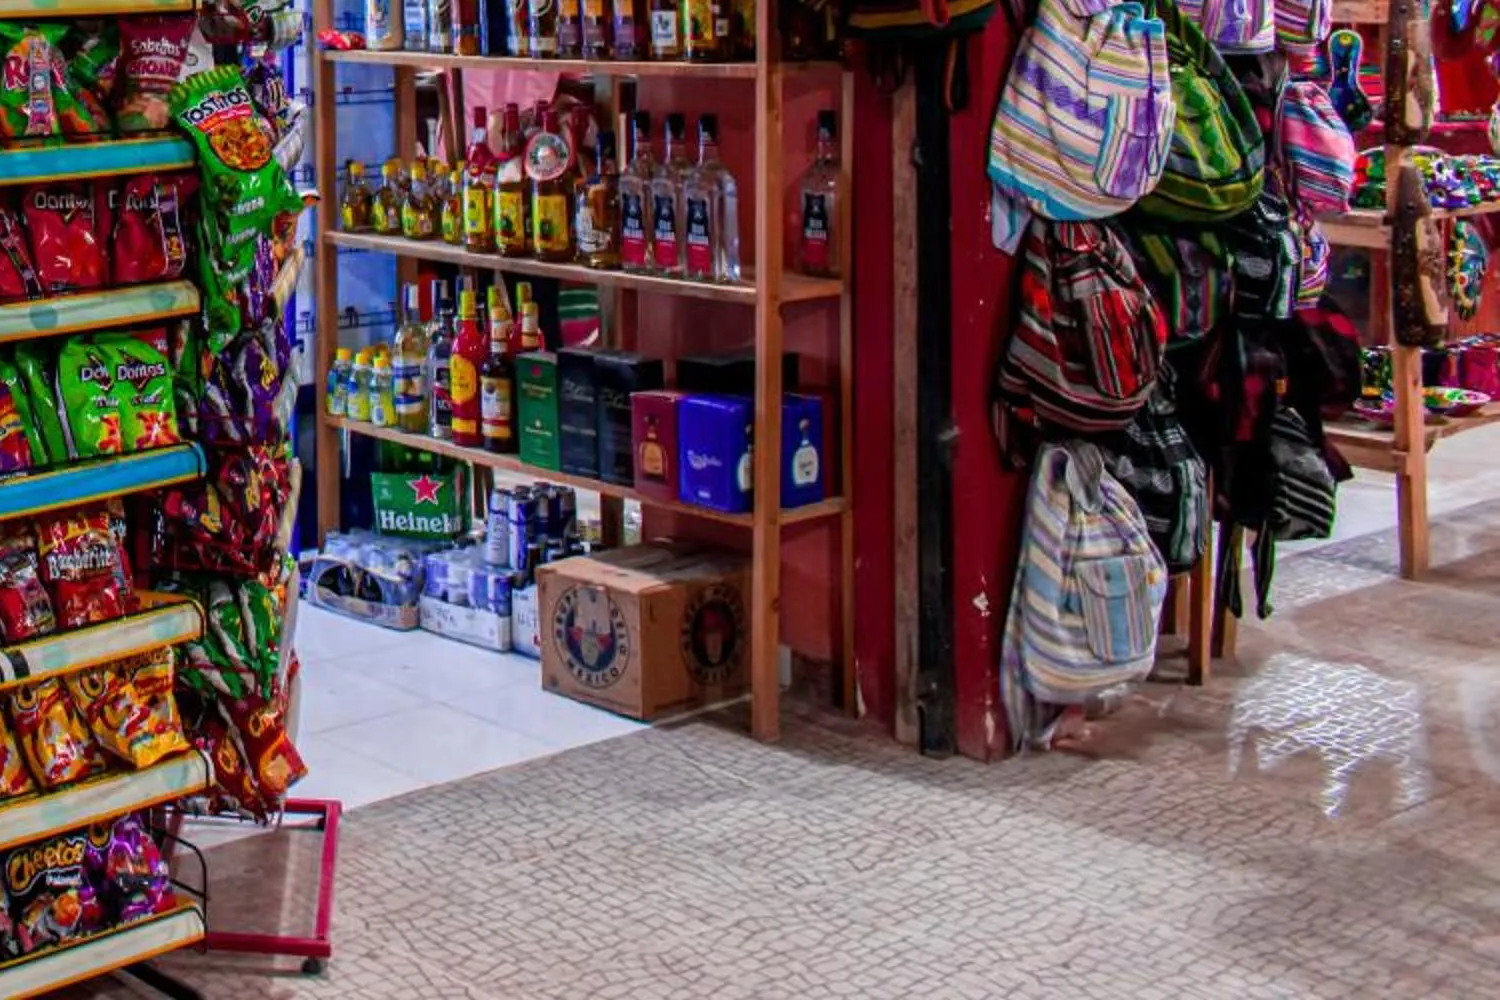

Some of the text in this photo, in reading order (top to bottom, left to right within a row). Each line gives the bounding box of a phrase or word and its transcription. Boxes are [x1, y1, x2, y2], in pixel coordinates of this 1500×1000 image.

[131, 36, 182, 56] Sabritas
[117, 362, 166, 381] Doritos
[8, 840, 85, 892] Cheetos
